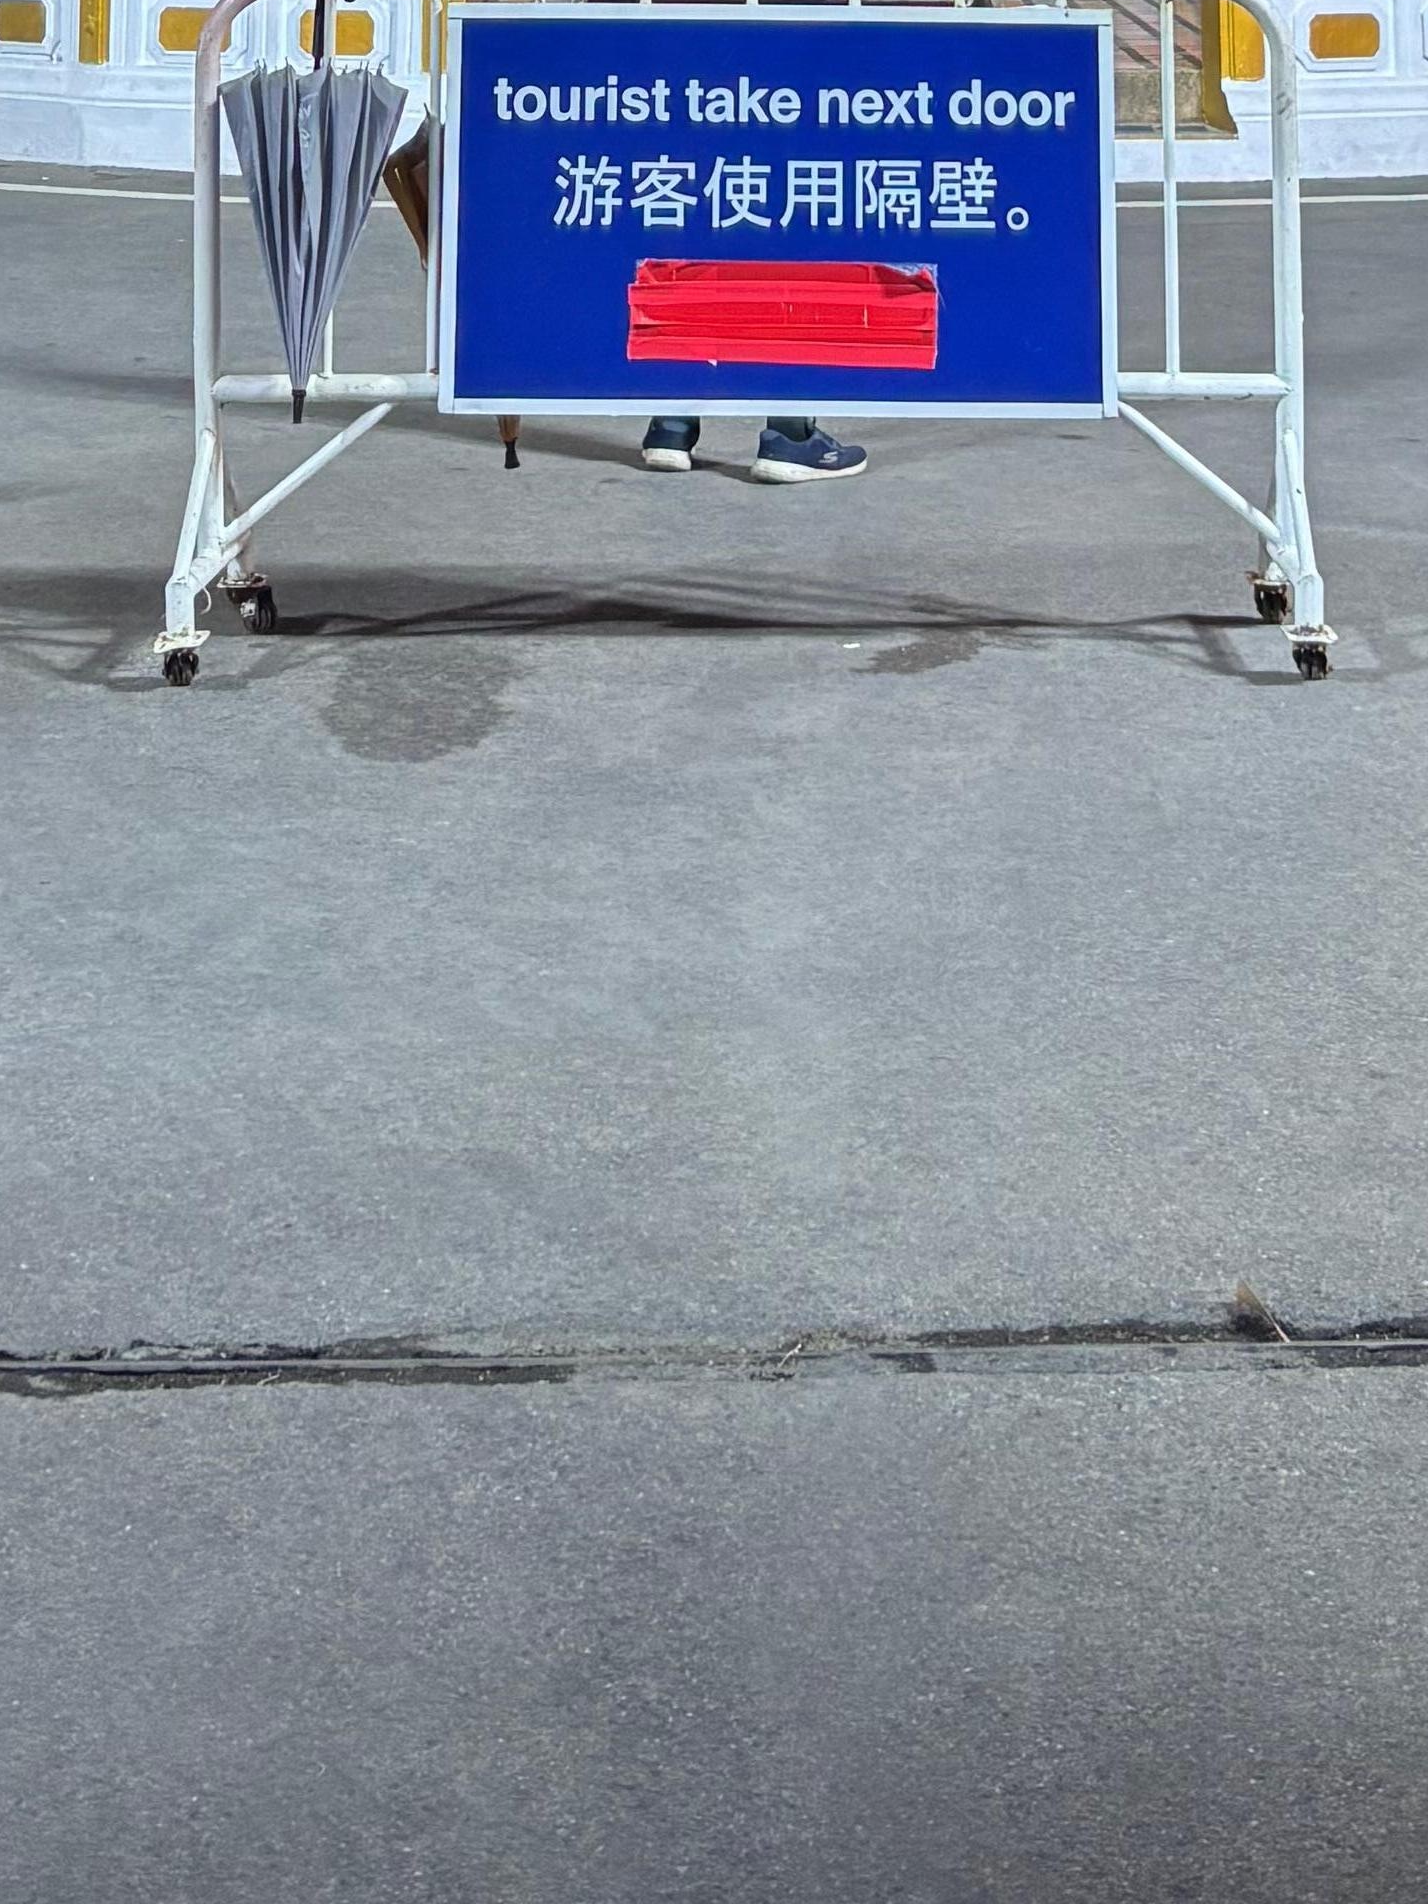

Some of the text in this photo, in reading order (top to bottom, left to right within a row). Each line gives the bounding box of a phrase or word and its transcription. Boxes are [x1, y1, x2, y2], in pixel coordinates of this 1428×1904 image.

[494, 75, 1075, 128] tourist take next door
[553, 154, 1031, 231] 游客使用隔壁。
